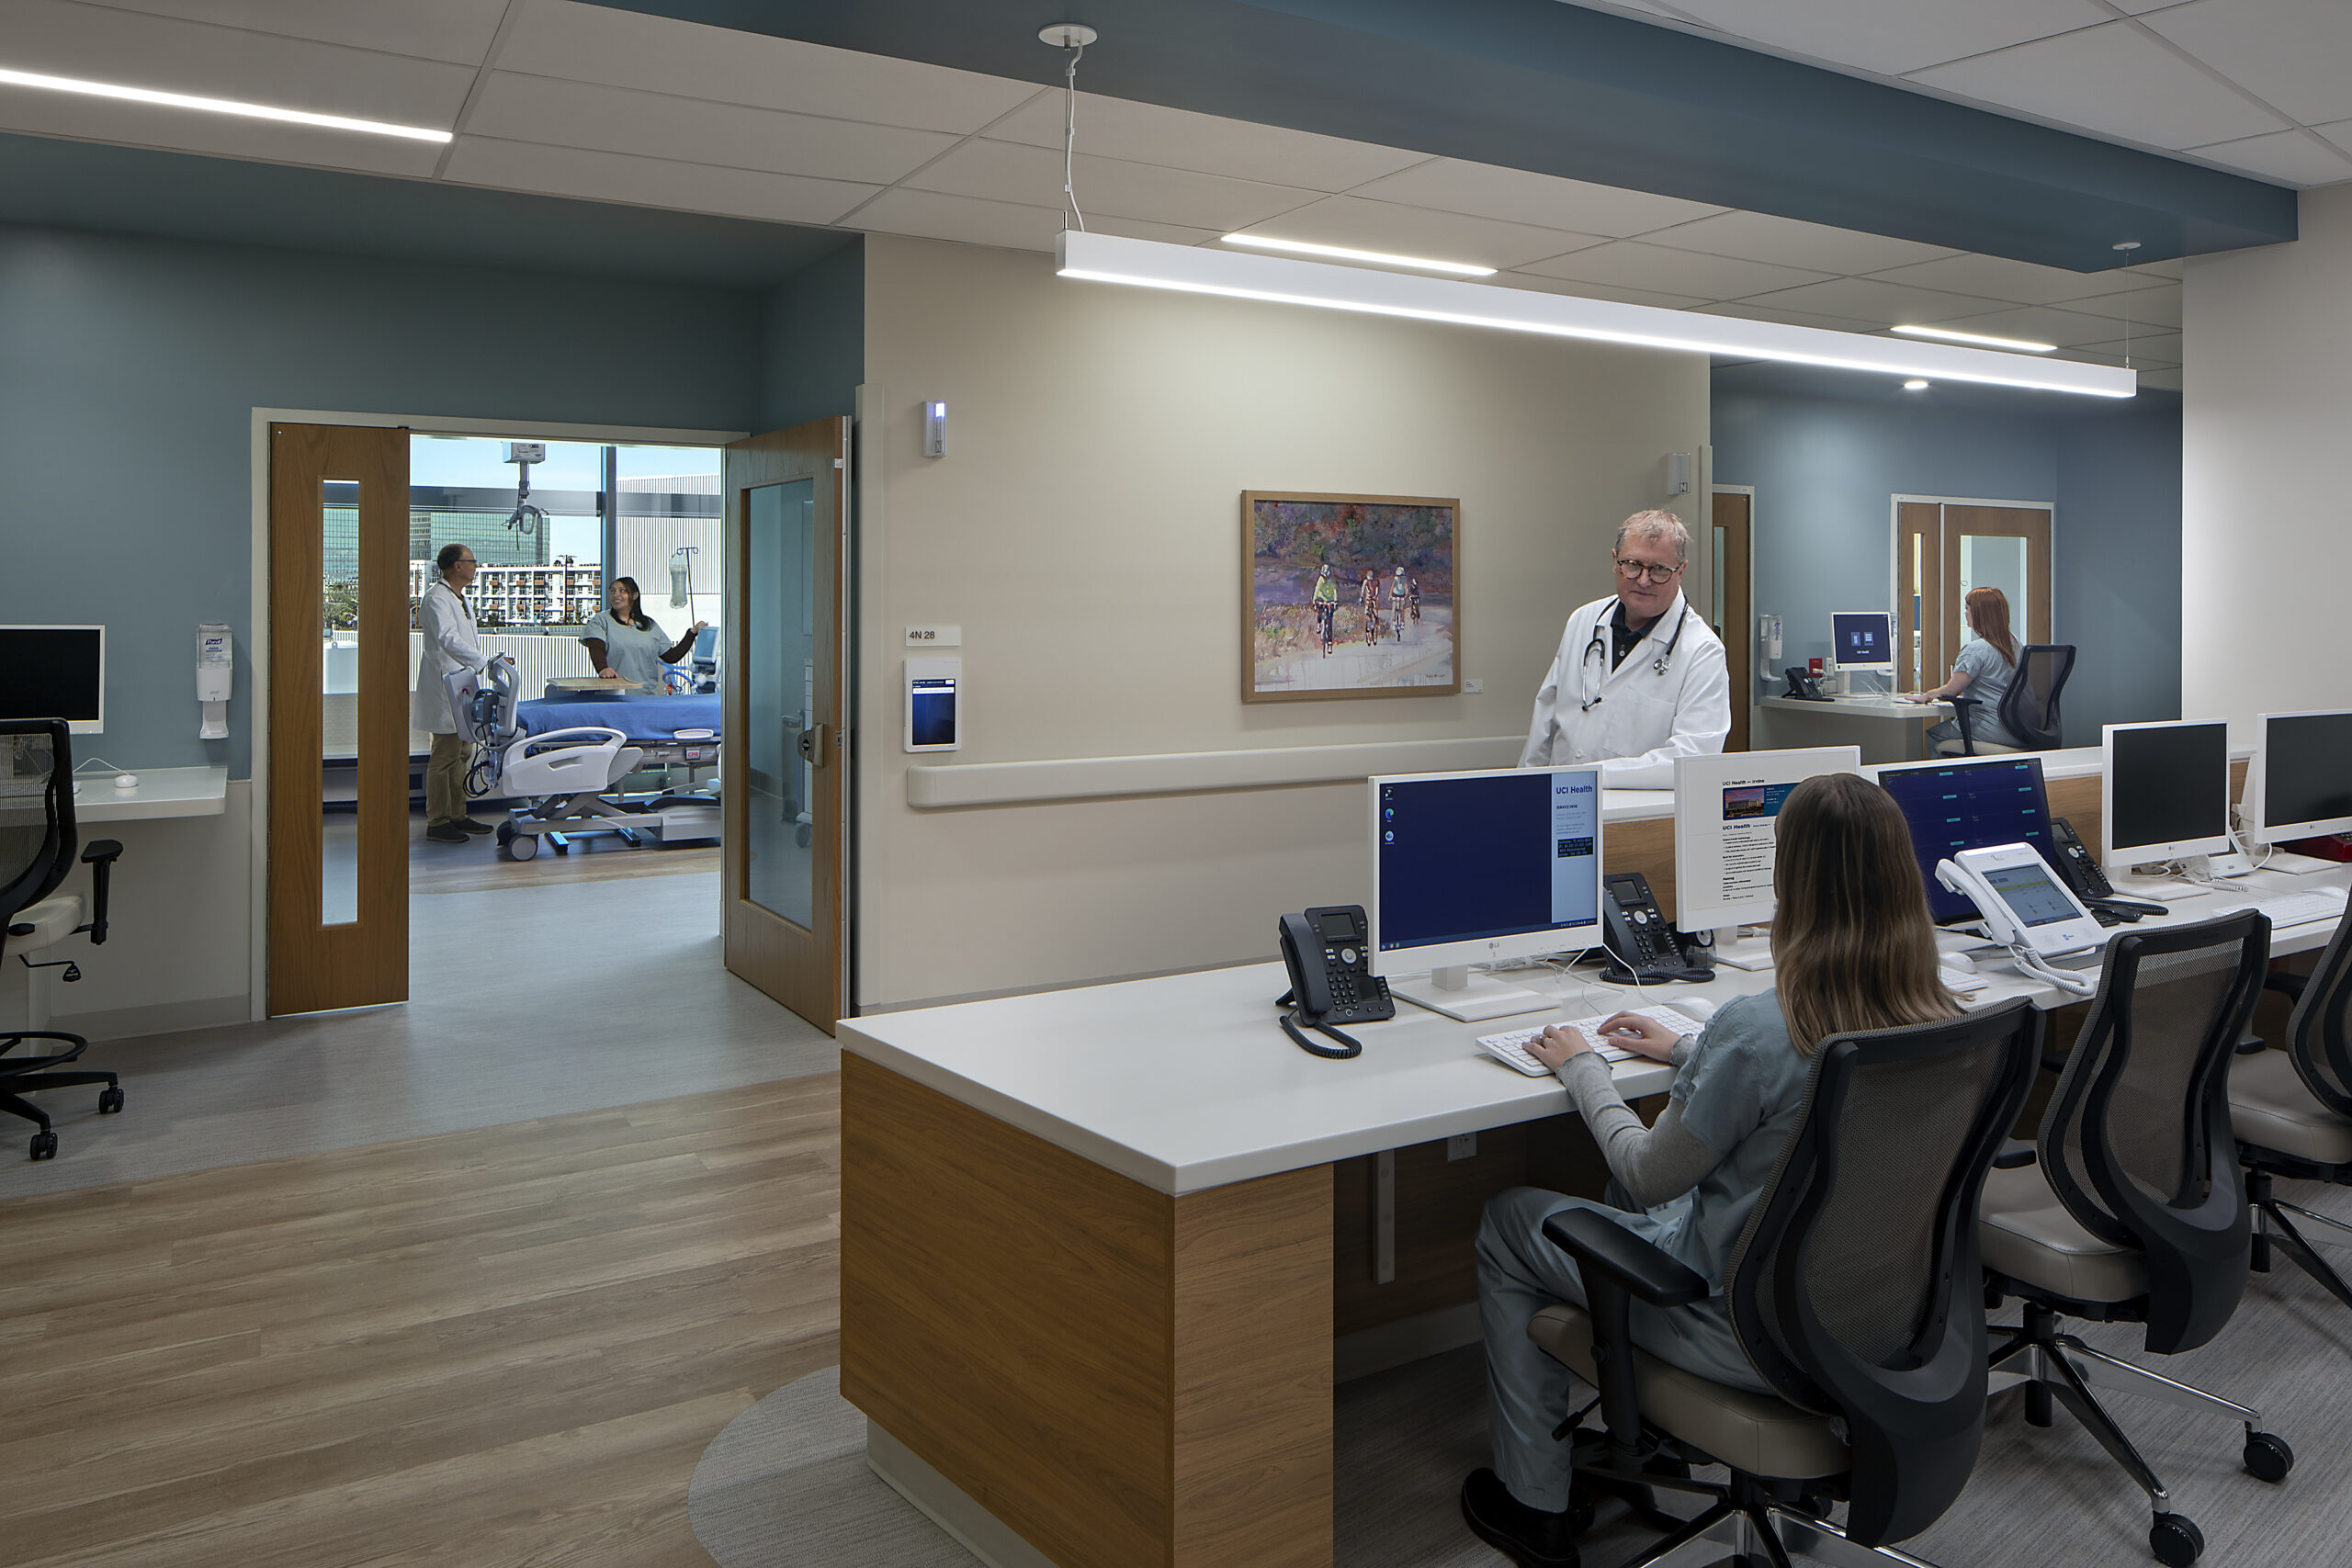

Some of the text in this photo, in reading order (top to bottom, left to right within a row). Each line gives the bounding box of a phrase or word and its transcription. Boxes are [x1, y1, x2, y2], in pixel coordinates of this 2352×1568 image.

[910, 631, 935, 639] 4N 28
[1570, 784, 1593, 794] Health
